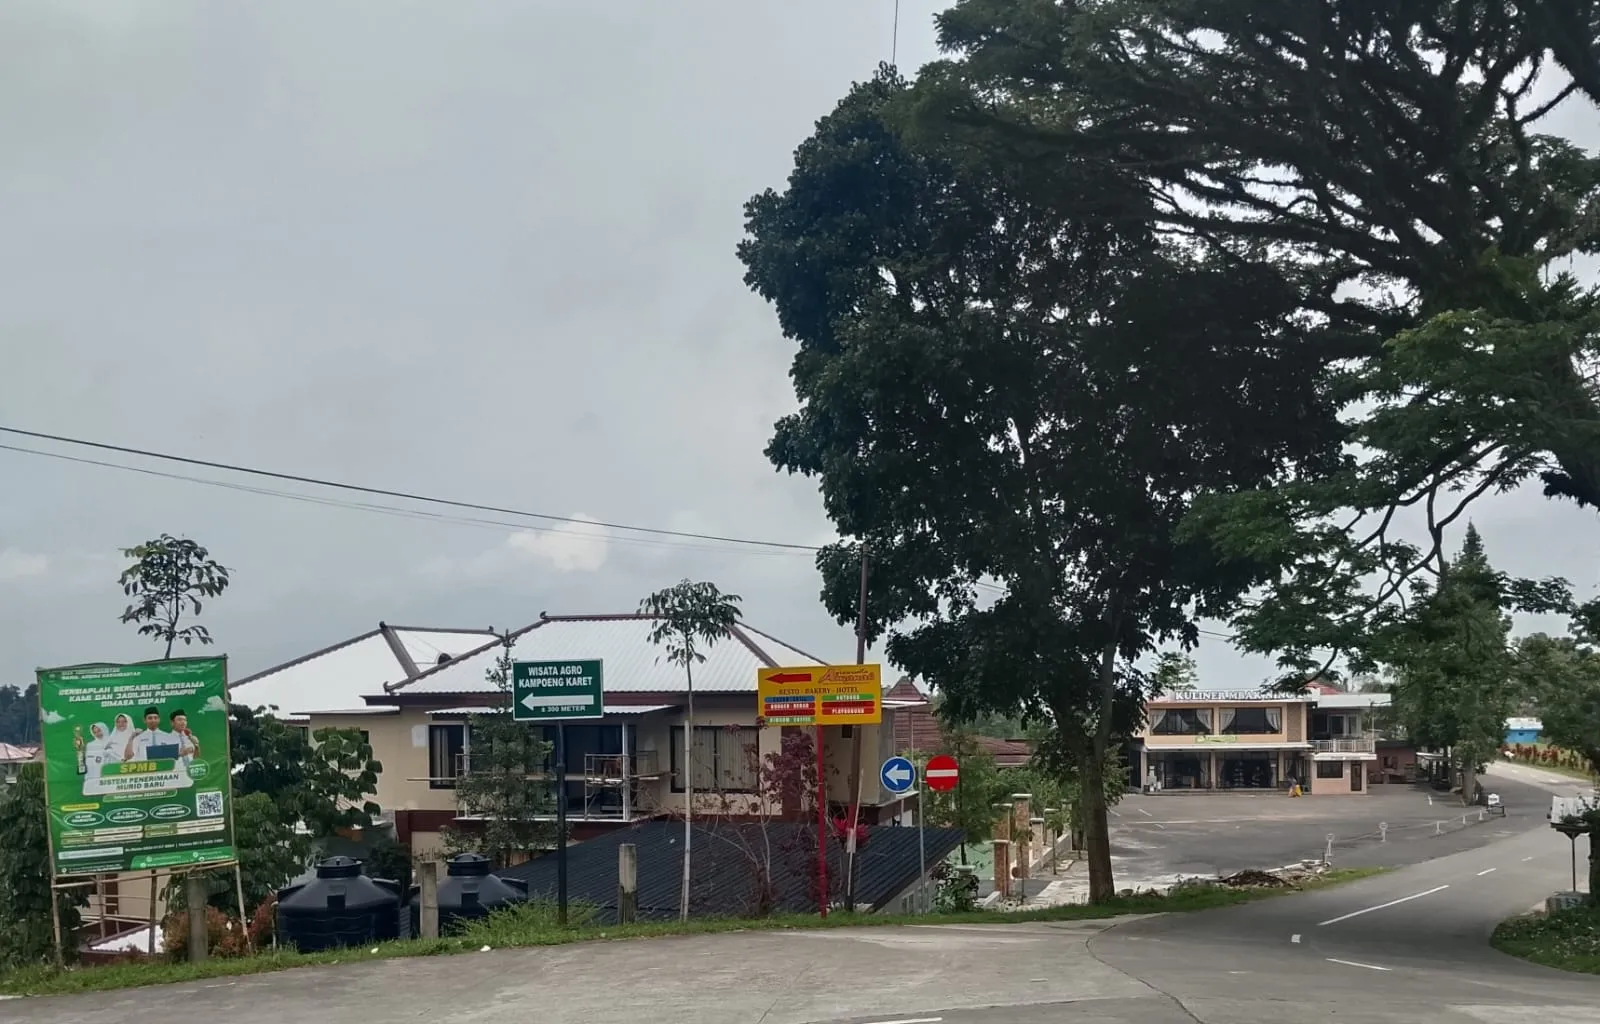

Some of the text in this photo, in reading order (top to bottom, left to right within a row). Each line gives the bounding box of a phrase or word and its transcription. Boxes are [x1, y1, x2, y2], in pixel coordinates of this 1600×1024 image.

[528, 665, 583, 676] WISATA AGRO
[114, 684, 162, 692] BERGABUNG
[164, 681, 205, 690] BERSAMA
[518, 676, 593, 688] KAMPOENG KARET
[1175, 690, 1225, 700] KULINER
[120, 762, 157, 773] SPMB
[99, 774, 179, 786] SISTEM PENERIMAAN
[116, 783, 142, 791] MURID
